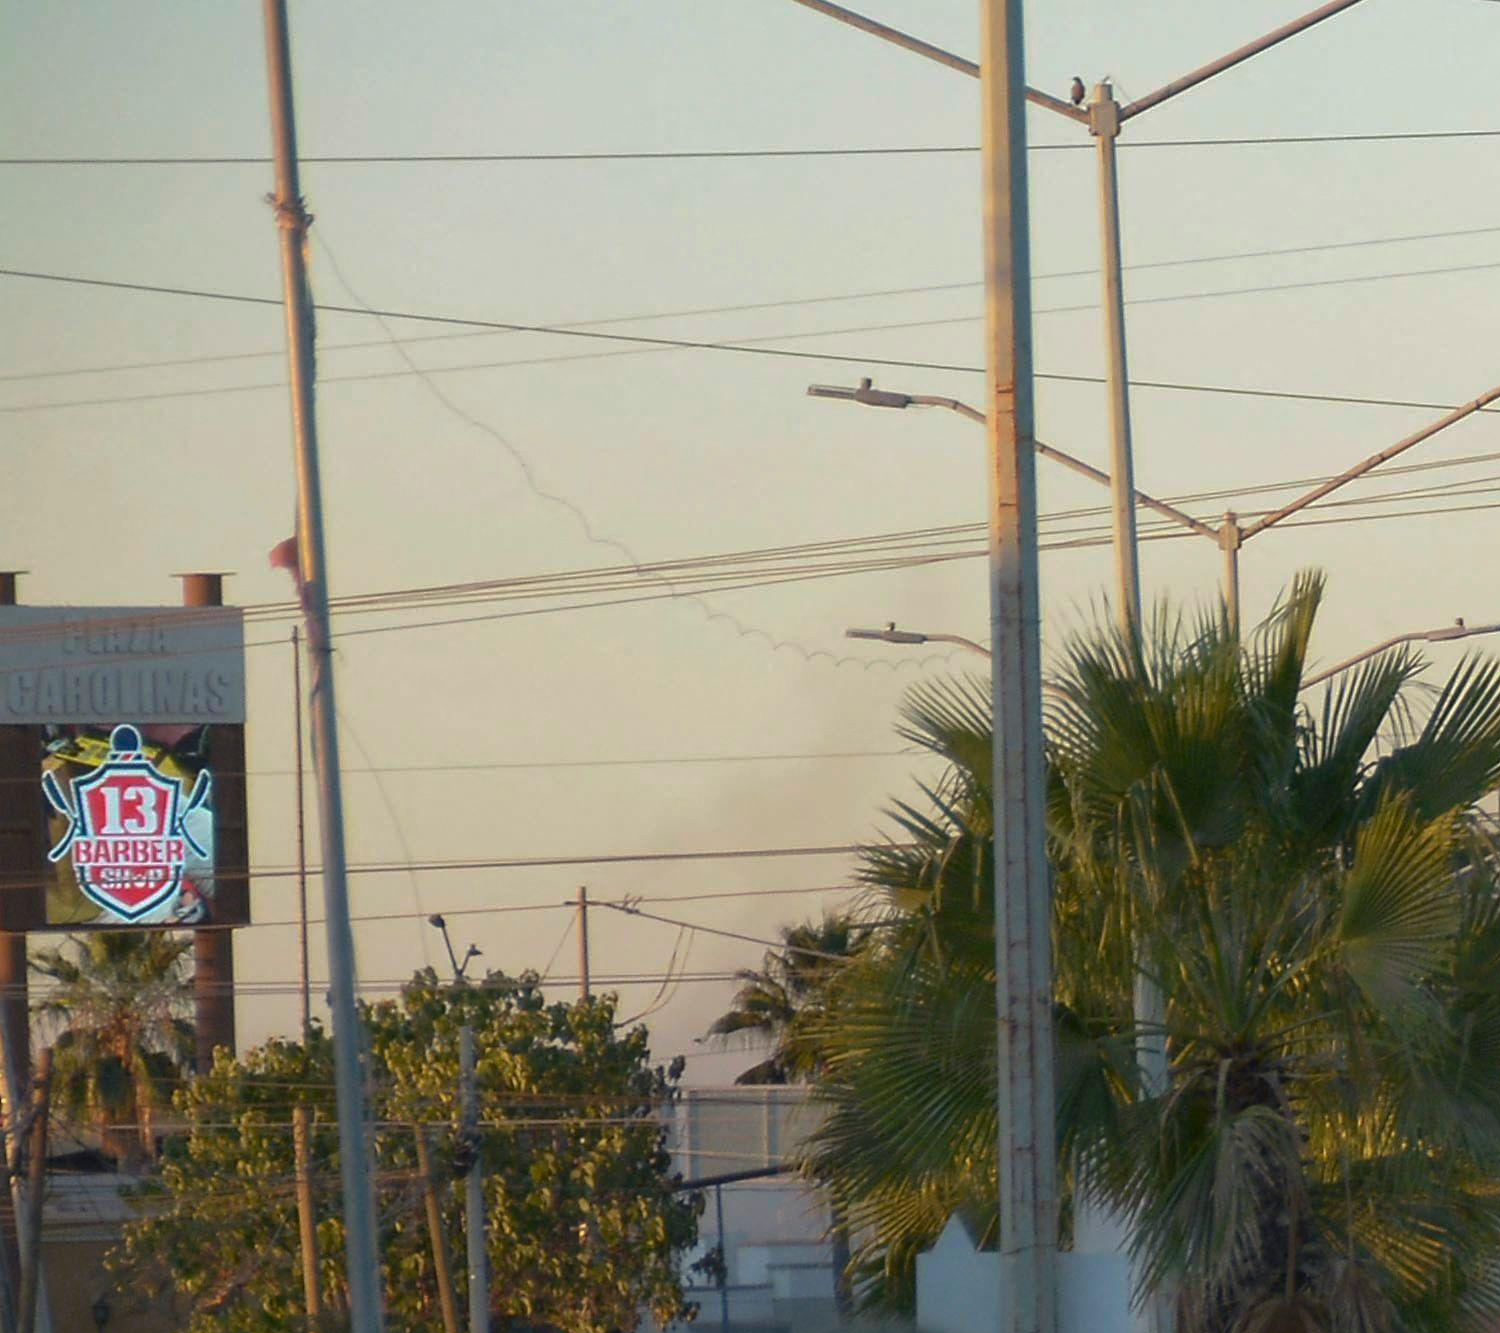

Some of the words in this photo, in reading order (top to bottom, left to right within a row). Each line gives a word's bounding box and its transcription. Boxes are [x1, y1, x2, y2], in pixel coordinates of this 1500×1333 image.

[62, 616, 171, 655] PLAZA
[6, 667, 232, 716] CAROLINAS
[100, 785, 159, 835] 13
[74, 839, 185, 864] BARBER
[100, 867, 166, 889] SHOP
